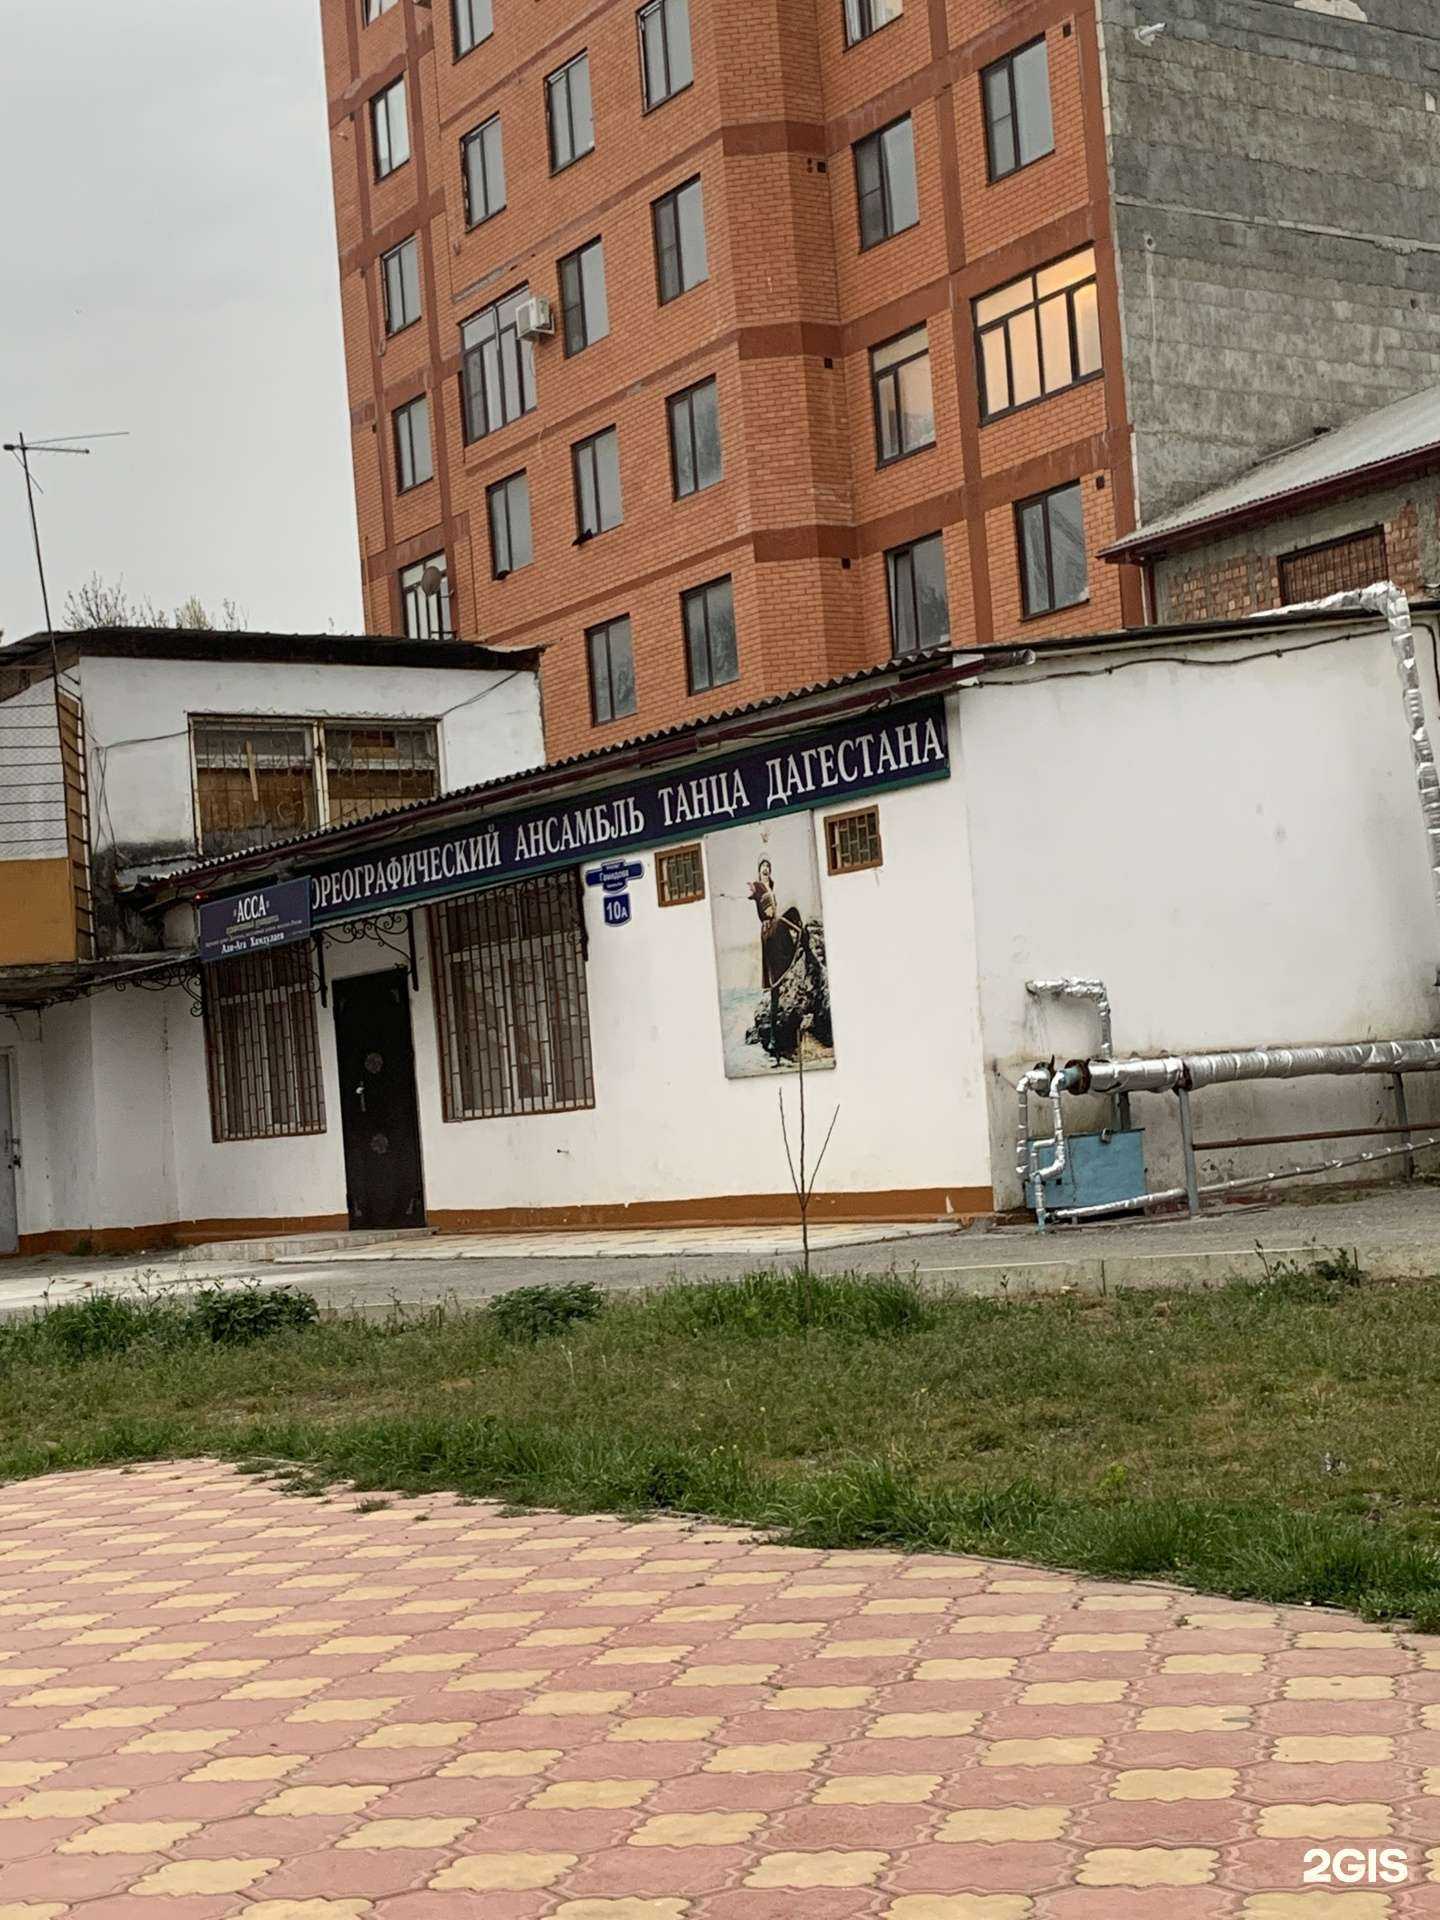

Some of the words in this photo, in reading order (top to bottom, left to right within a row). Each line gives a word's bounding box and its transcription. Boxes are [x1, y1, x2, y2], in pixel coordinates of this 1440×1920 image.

[515, 796, 645, 862] АНСАМБЛЬ
[658, 768, 750, 827] ТАНЦА
[766, 717, 945, 809] ДАГЕСТАНА
[606, 900, 629, 921] 10А
